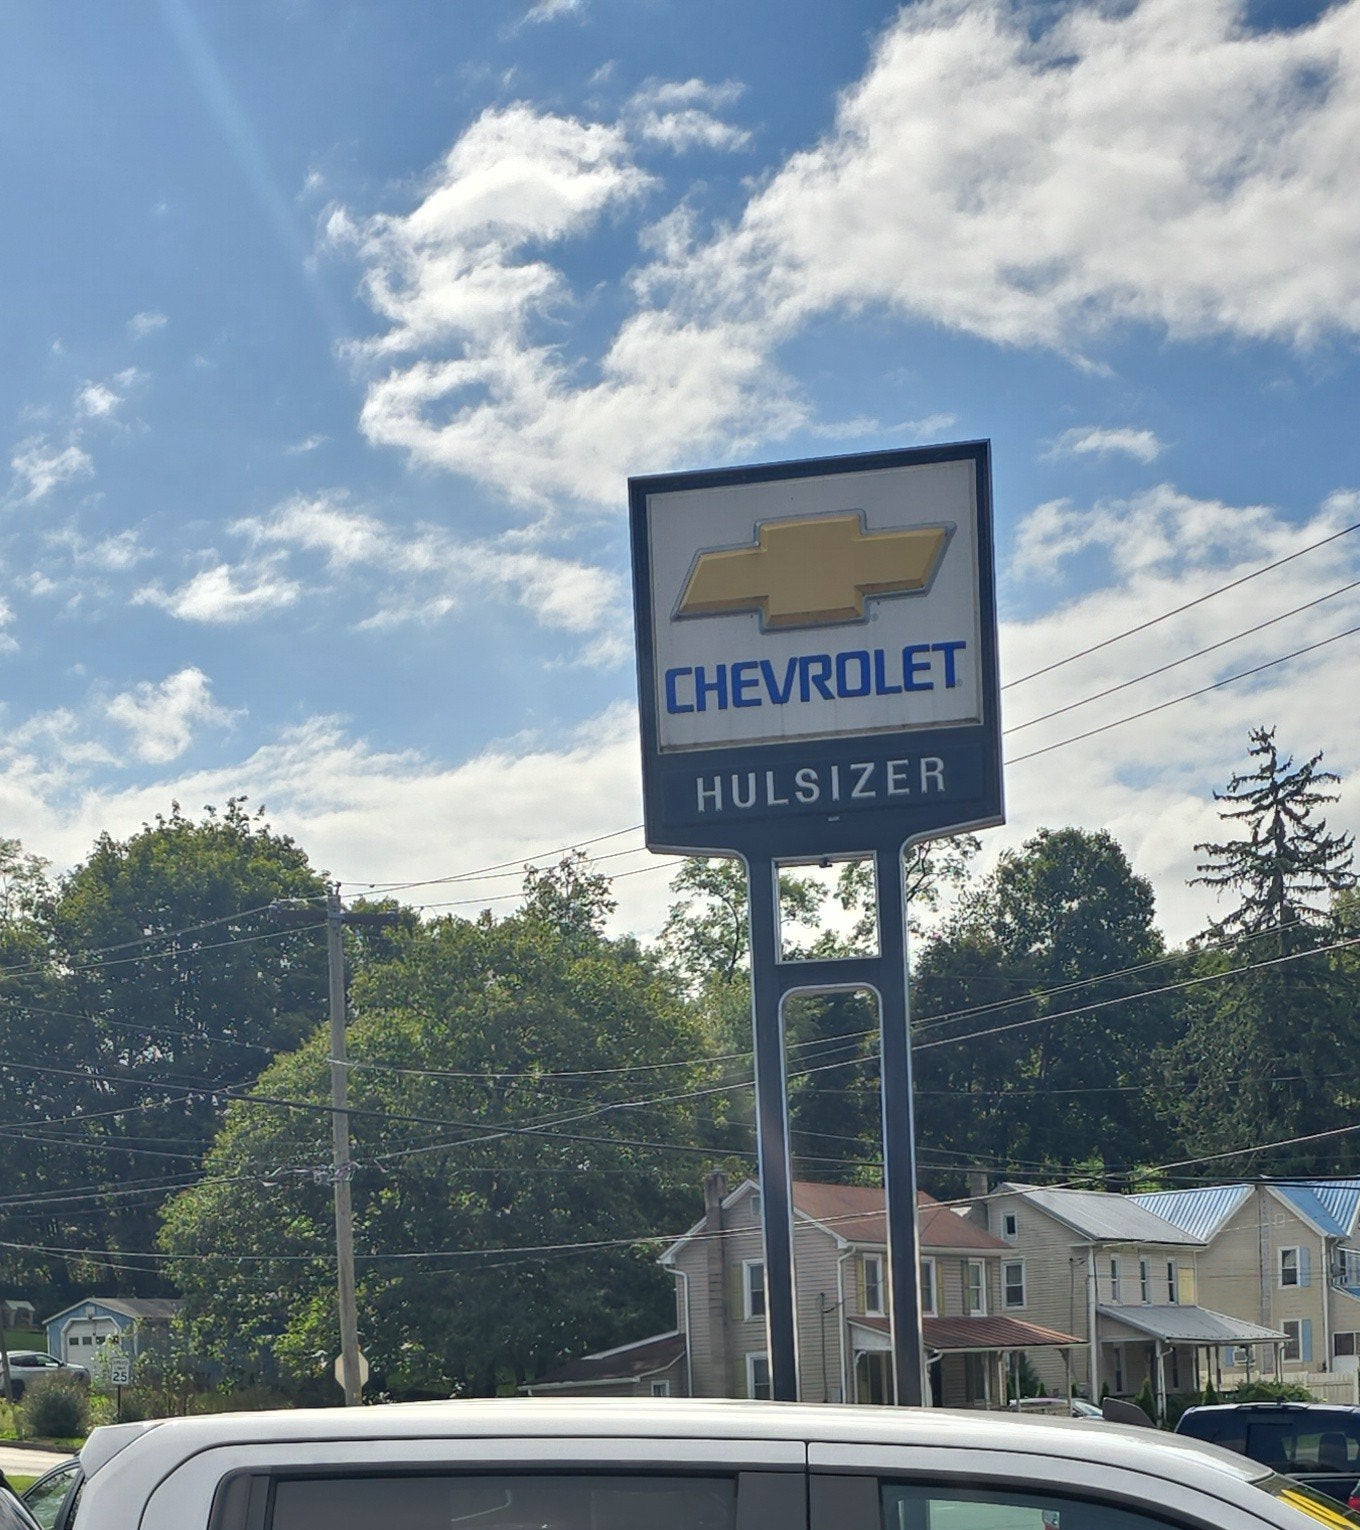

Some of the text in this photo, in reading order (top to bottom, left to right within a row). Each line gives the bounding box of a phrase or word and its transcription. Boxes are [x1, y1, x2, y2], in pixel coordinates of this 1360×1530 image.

[665, 640, 967, 715] CHEVROLET
[696, 756, 946, 814] HULSIZER
[113, 1371, 128, 1382] 25
